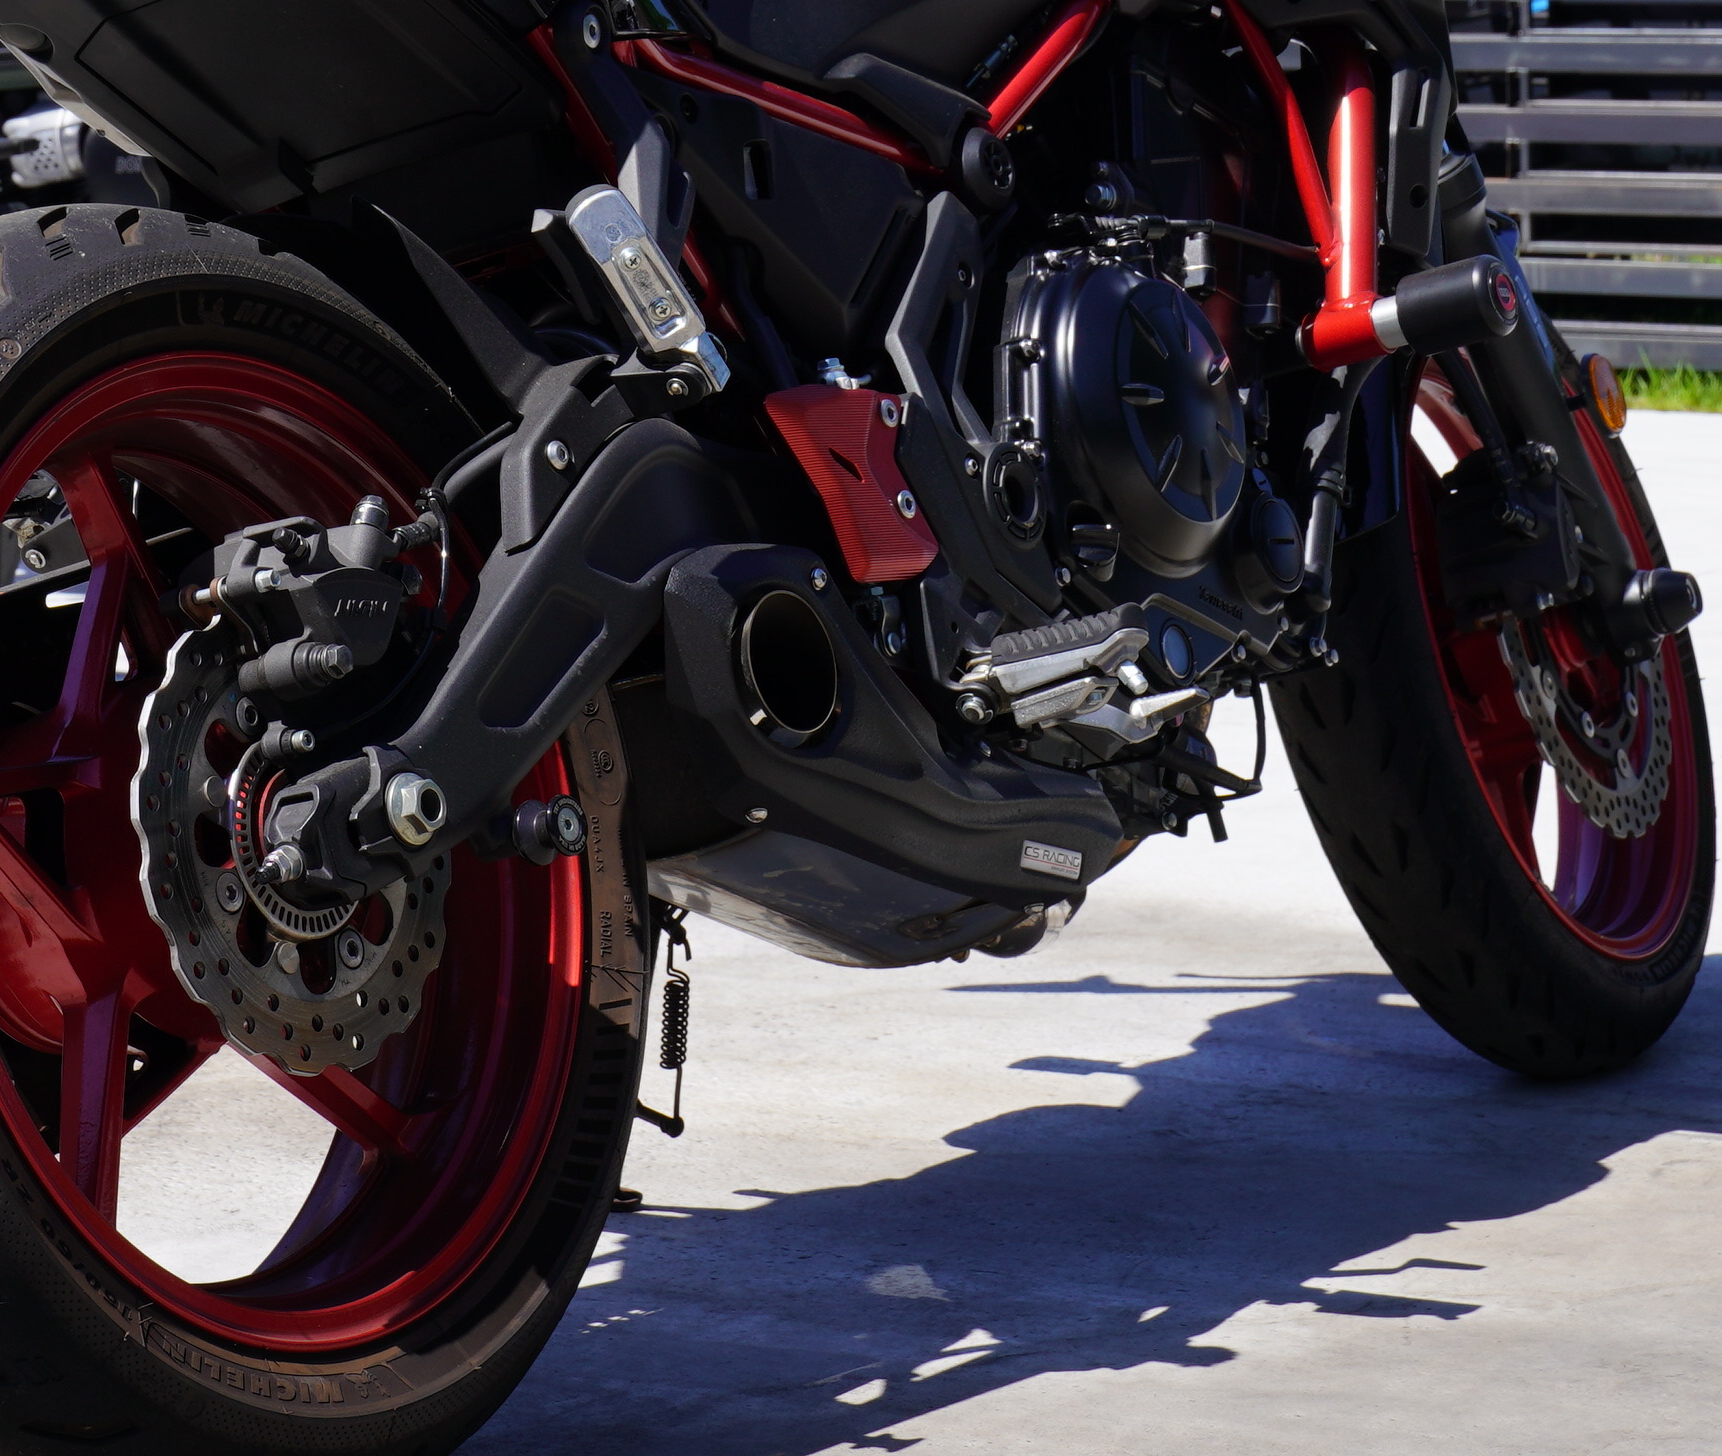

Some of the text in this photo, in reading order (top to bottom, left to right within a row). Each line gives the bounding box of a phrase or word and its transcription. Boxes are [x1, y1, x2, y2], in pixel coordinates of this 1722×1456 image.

[232, 299, 405, 394] MICHELIN
[1024, 845, 1080, 868] CS RACING
[599, 909, 613, 959] RADIAL
[623, 893, 634, 937] SPAIN
[161, 1332, 345, 1404] MICHELIN
